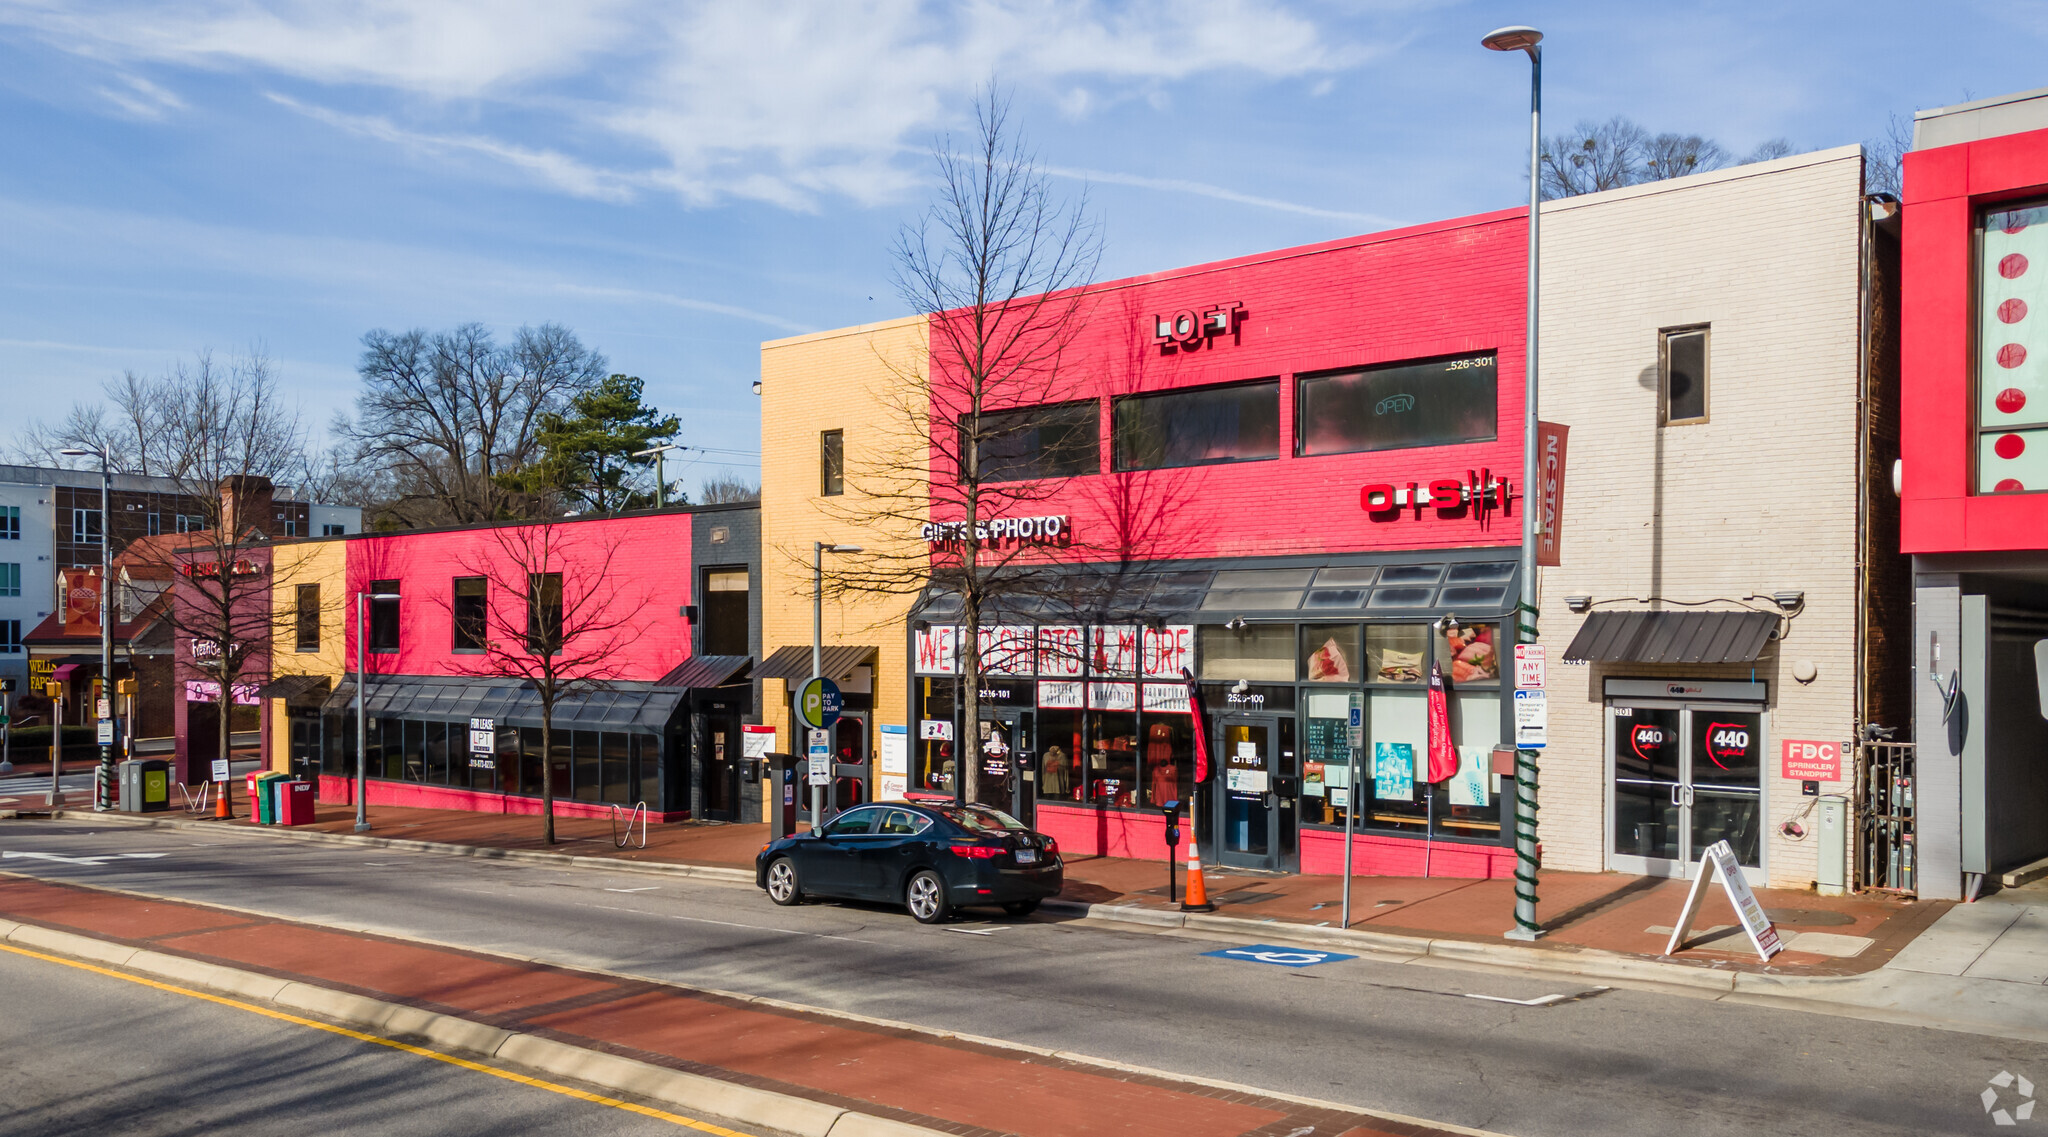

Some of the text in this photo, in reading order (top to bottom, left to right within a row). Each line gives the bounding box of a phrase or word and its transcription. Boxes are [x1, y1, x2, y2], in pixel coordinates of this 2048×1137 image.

[1152, 301, 1243, 345] LOFT
[1445, 356, 1493, 371] 526-301
[1375, 397, 1413, 415] OPEN
[1543, 435, 1558, 552] NC STATE
[921, 516, 1061, 542] GIFTS & PHOTO
[918, 628, 951, 671] WE
[1000, 628, 1079, 674] SHIRTS
[1094, 627, 1109, 674] &
[1118, 628, 1189, 675] MORE
[1516, 648, 1525, 657] NO
[1522, 662, 1540, 671] ANY
[1521, 674, 1541, 682] TIME
[822, 692, 836, 700] PAY
[1144, 687, 1188, 697] PROMOTIONA
[806, 693, 820, 713] P
[1228, 693, 1265, 704] 2526-100
[1616, 708, 1631, 716] 301
[480, 718, 494, 730] LEASE
[473, 731, 491, 745] LPT
[1637, 730, 1663, 743] 440
[1713, 730, 1749, 748] 440
[1788, 742, 1834, 760] FDC
[1787, 761, 1835, 770] SPRINKLER/
[785, 769, 792, 780] P
[1789, 770, 1833, 778] STANDPIPE
